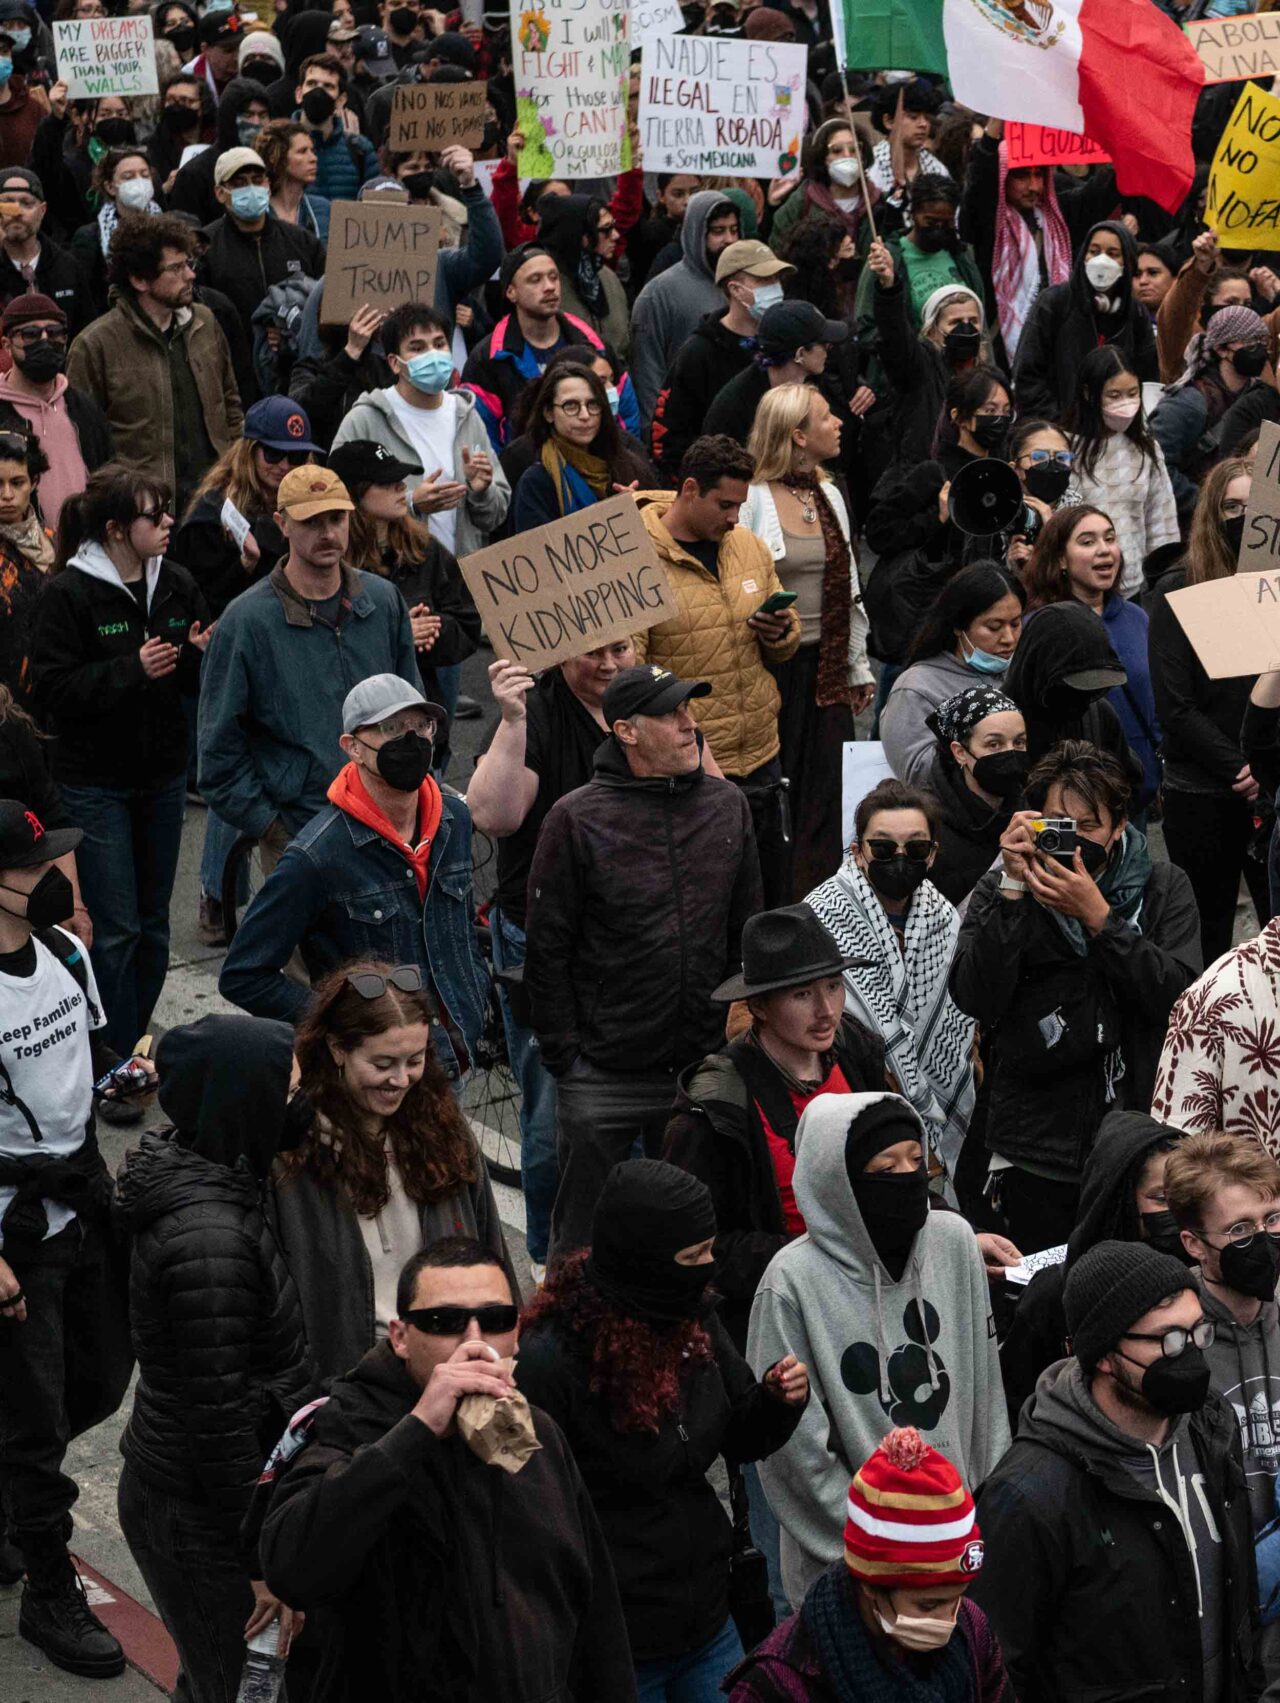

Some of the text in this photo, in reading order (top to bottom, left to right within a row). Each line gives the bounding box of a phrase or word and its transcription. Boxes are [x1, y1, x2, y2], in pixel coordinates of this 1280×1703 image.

[58, 19, 148, 41] MY DREAMS
[561, 19, 573, 45] I
[60, 41, 146, 63] ARE BIGGER
[521, 51, 583, 79] FIGHT
[656, 38, 731, 81] NADIE
[747, 42, 779, 83] ES
[1208, 51, 1277, 79] VIVA
[71, 60, 142, 79] THAN YOUR
[84, 74, 142, 94] WALLS
[530, 86, 553, 108] for
[566, 85, 608, 108] those
[649, 76, 719, 113] ILEGAL
[732, 84, 758, 115] EN
[563, 106, 620, 139] CAN'T
[646, 117, 783, 150] TIERRA ROBADA
[1220, 138, 1259, 174] NO
[343, 217, 430, 252] DUMP
[342, 262, 431, 299] TRUMP
[481, 512, 639, 606] NO MORE
[500, 565, 664, 661] KIDNAPPING
[33, 992, 82, 1031] Families
[13, 1020, 77, 1060] Together
